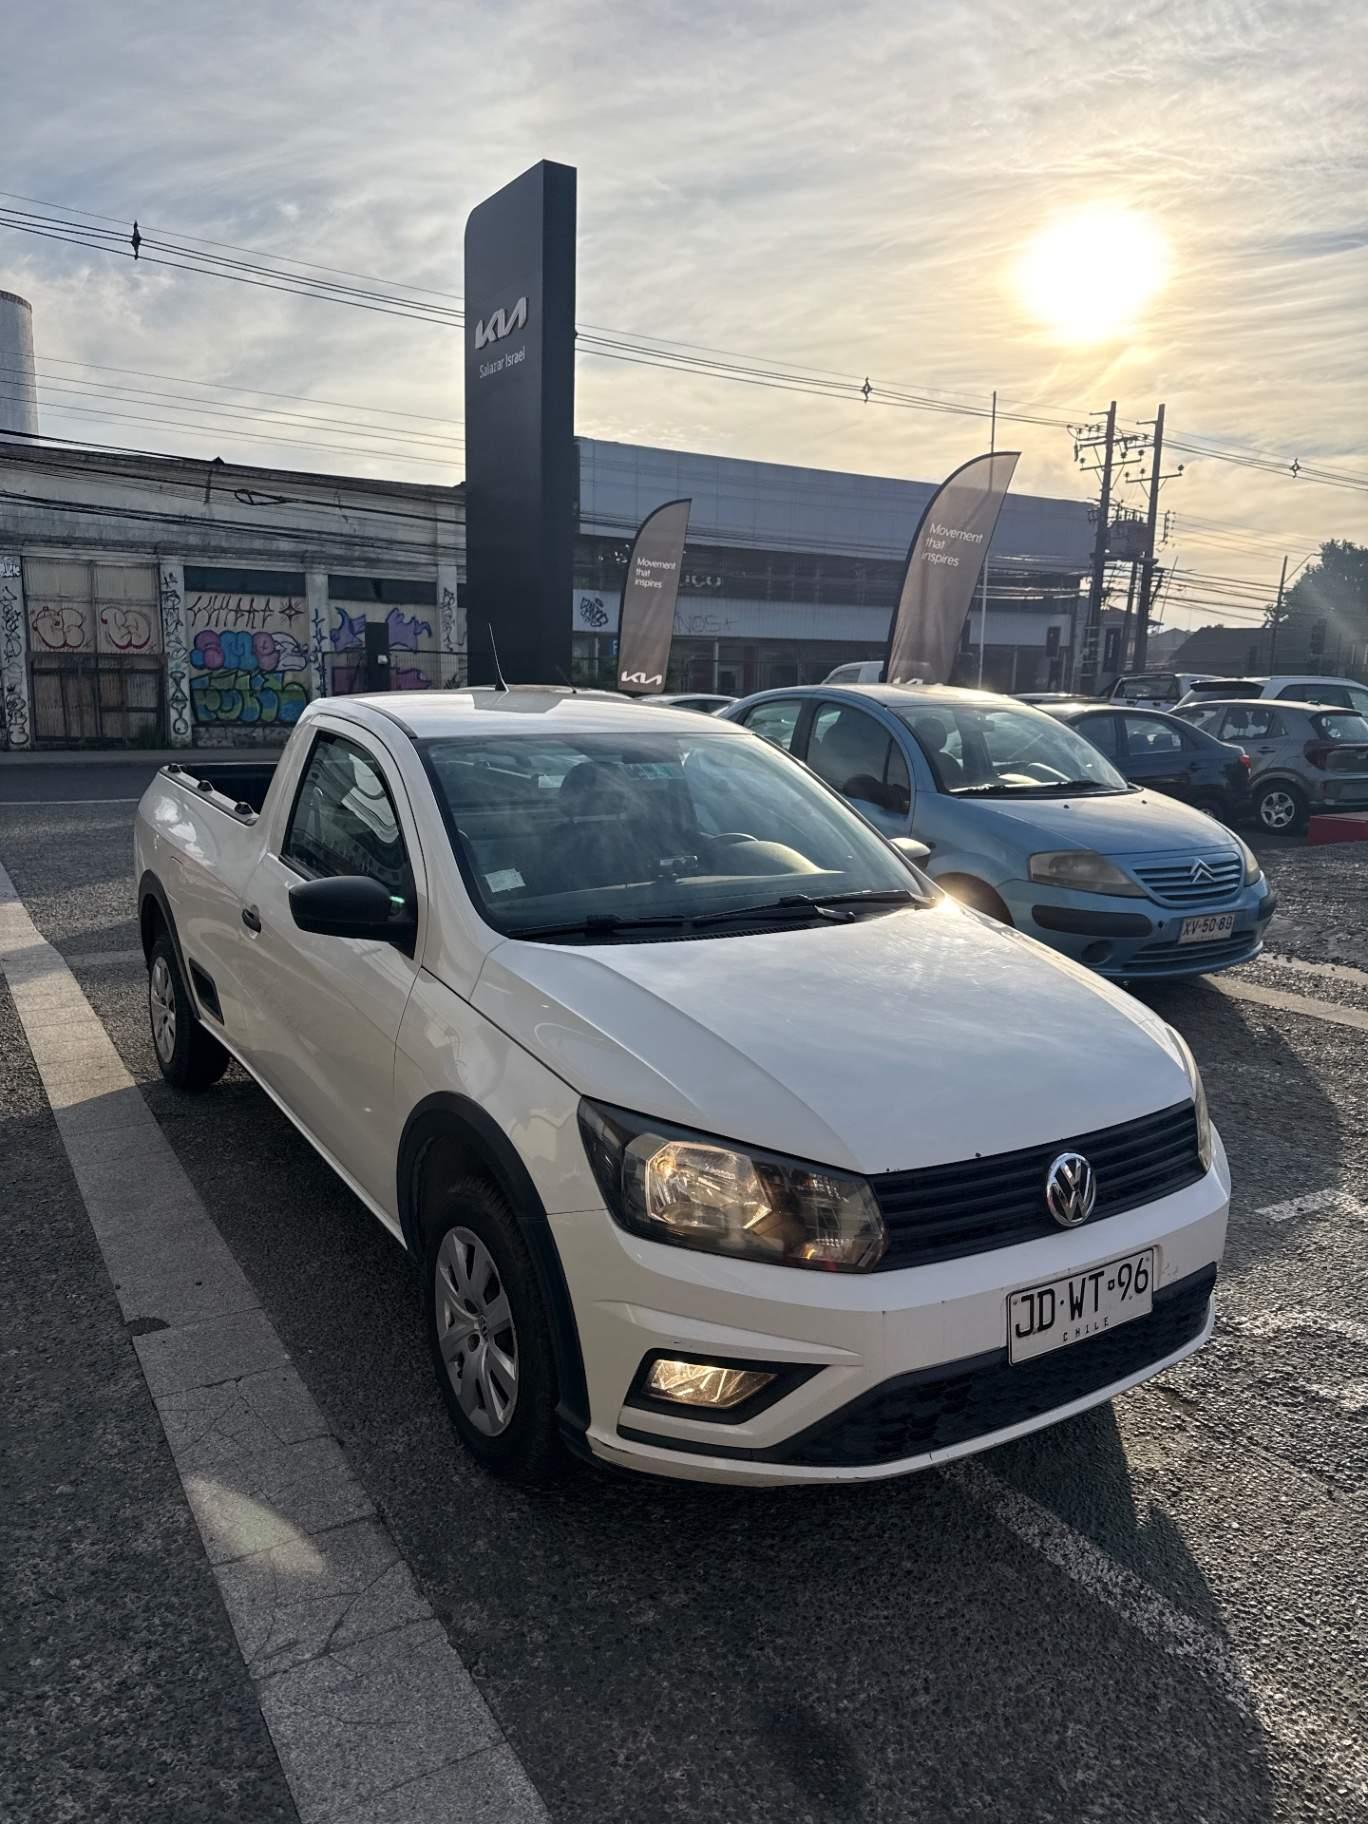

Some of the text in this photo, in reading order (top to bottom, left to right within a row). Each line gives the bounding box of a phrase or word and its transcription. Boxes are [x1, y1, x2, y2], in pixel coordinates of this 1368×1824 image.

[480, 346, 526, 378] Salazar Israel
[929, 522, 983, 544] Movement
[925, 538, 945, 550] that
[637, 556, 676, 570] Movement
[920, 551, 960, 567] inspires
[635, 567, 651, 578] that
[634, 578, 662, 590] inspires
[1062, 1317, 1110, 1342] CHILE
